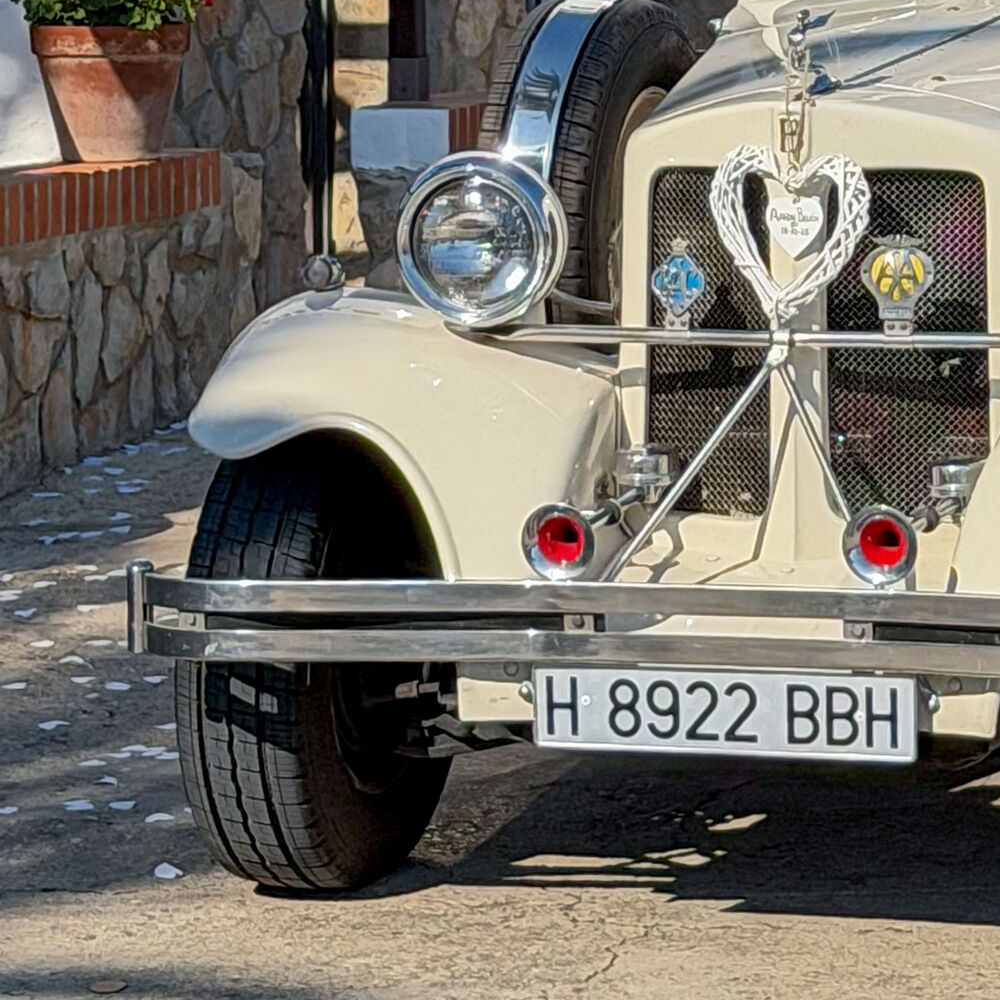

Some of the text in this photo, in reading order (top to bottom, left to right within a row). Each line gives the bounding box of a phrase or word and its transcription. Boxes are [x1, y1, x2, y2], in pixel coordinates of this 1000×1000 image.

[545, 675, 898, 749] H 8922 BBH
